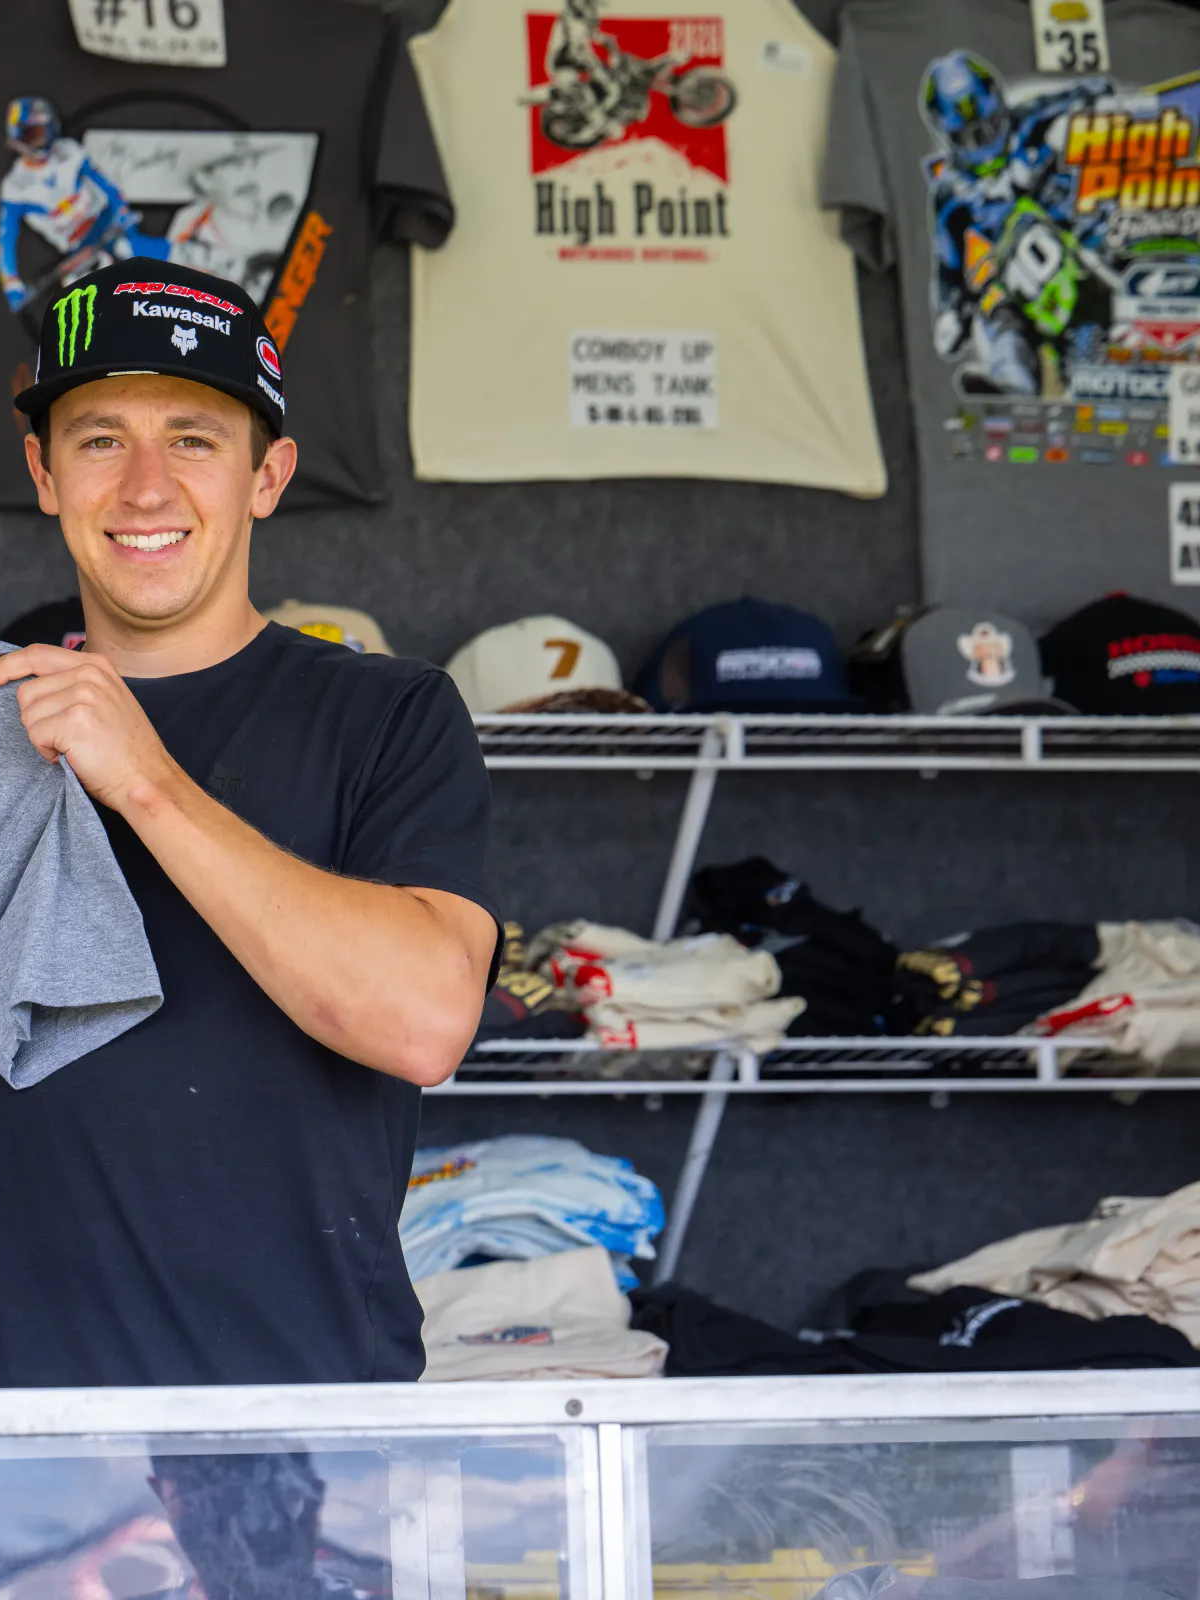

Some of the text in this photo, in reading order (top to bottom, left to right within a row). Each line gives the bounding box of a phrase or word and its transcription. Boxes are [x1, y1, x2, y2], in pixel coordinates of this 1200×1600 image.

[1066, 107, 1192, 172] High
[535, 180, 730, 246] High Point
[113, 282, 243, 315] PRO CIRCUIT
[132, 301, 231, 336] Kawasaki
[653, 373, 715, 397] TANK
[543, 638, 582, 681] 7
